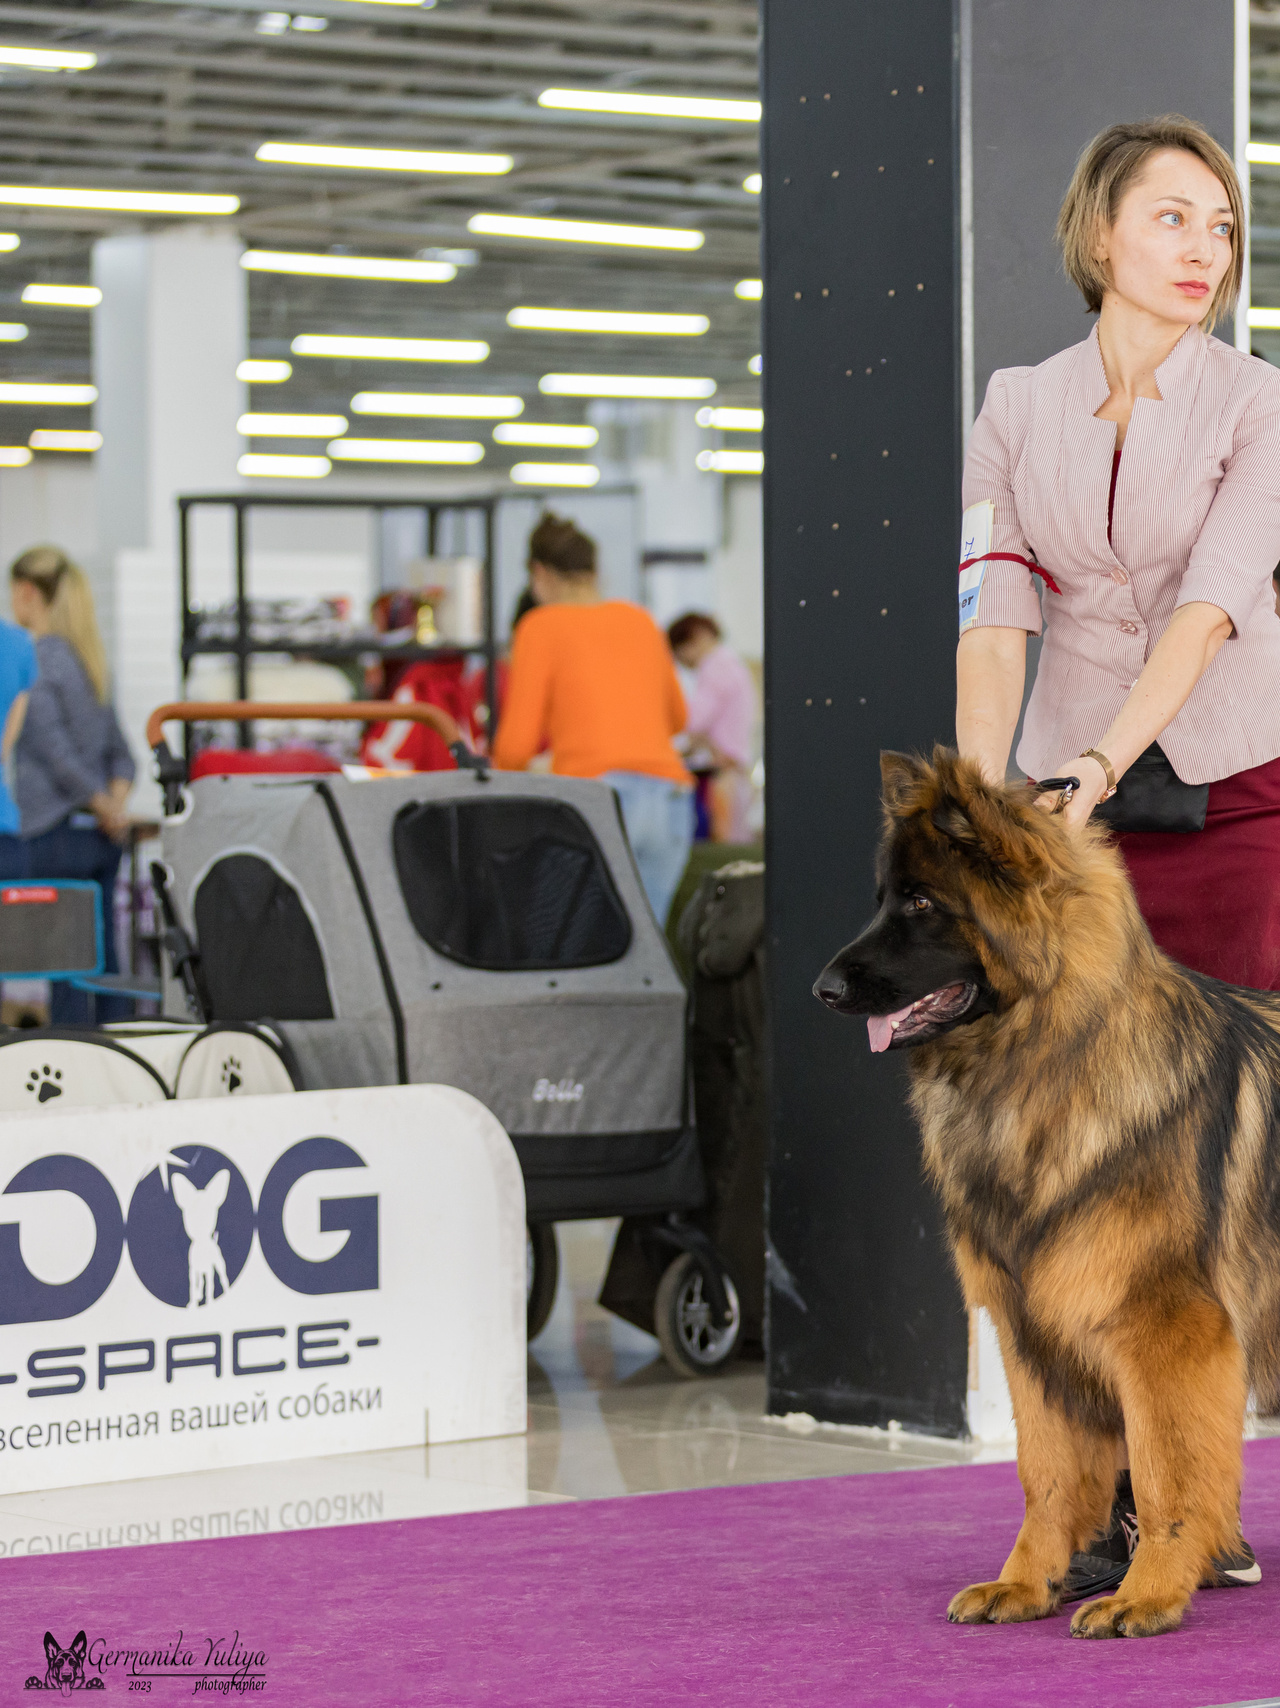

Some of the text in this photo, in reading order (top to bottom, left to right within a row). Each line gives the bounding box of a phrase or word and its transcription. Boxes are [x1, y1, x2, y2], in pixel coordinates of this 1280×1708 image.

[0, 1135, 381, 1326] DOG
[171, 1392, 269, 1432] вашей
[277, 1382, 383, 1420] собаки
